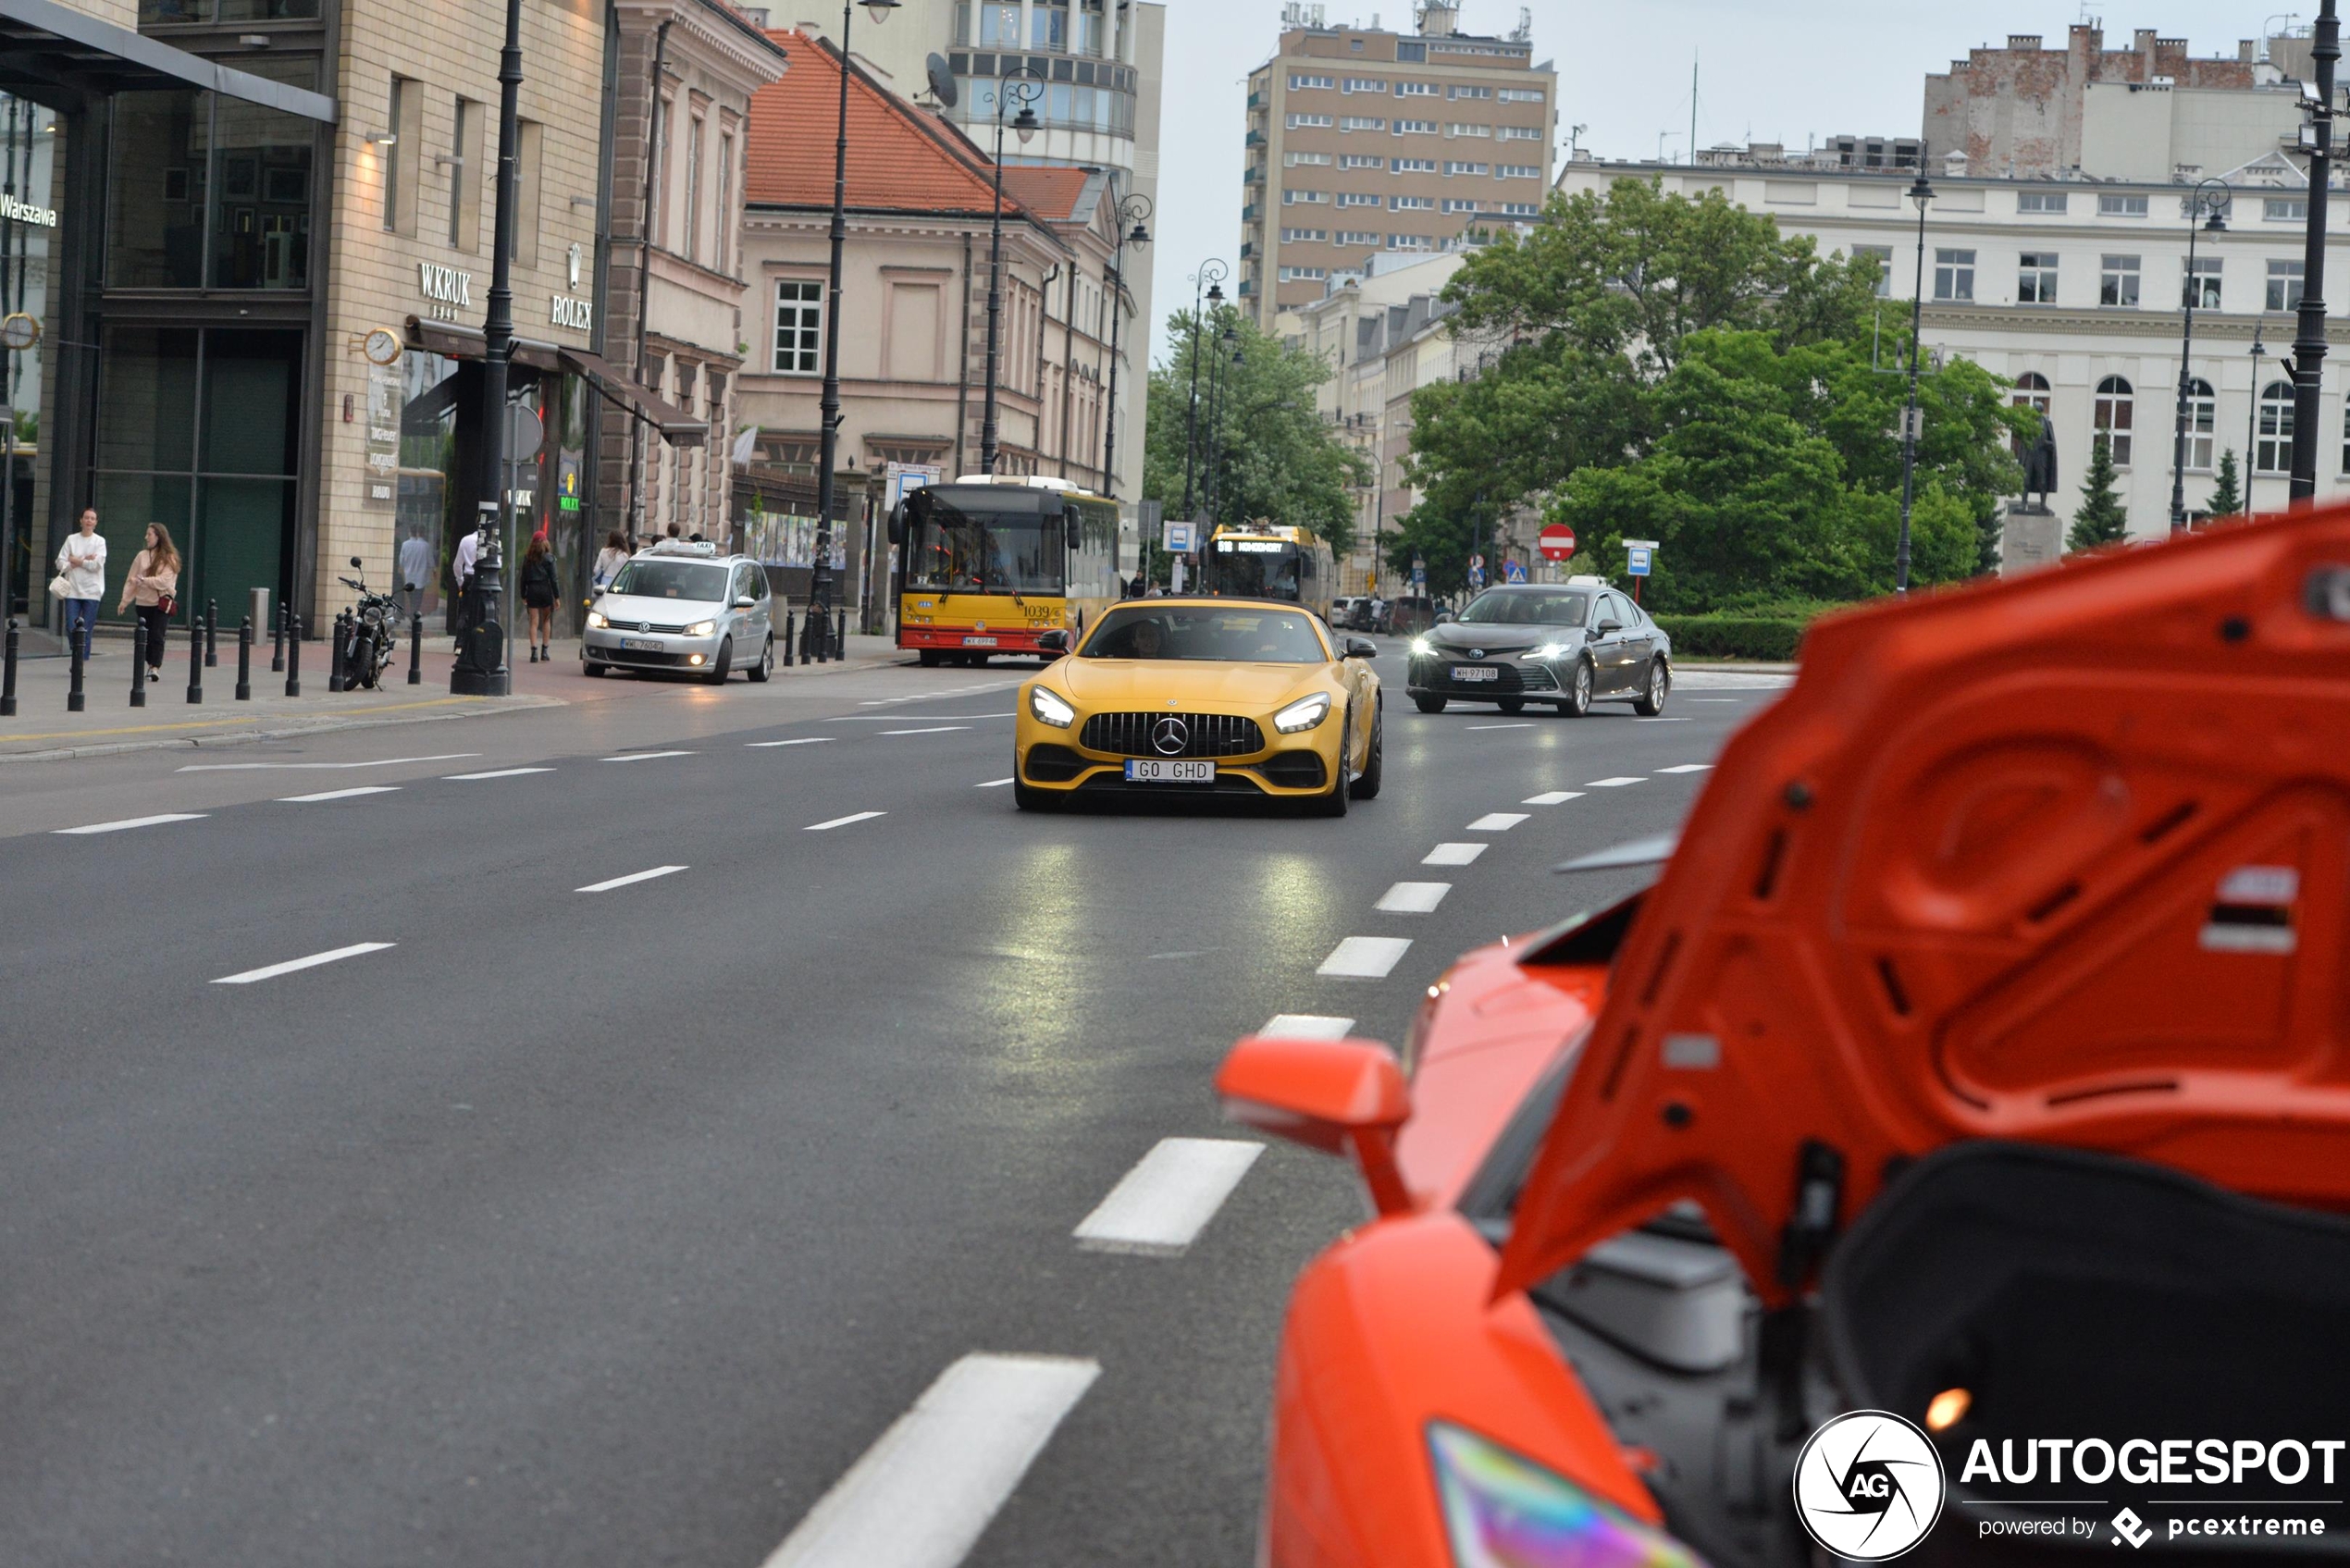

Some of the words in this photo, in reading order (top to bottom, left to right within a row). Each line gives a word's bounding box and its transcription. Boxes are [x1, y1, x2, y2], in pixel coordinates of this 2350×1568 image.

[1, 192, 56, 227] Warszawa
[421, 263, 472, 306] W.KRUK
[433, 304, 458, 322] 1840
[551, 295, 592, 330] ROLEX
[372, 485, 390, 500] RADO
[1024, 605, 1050, 618] 1039
[1456, 668, 1468, 677] WH
[1469, 669, 1496, 678] 97108
[1173, 763, 1206, 778] GHD
